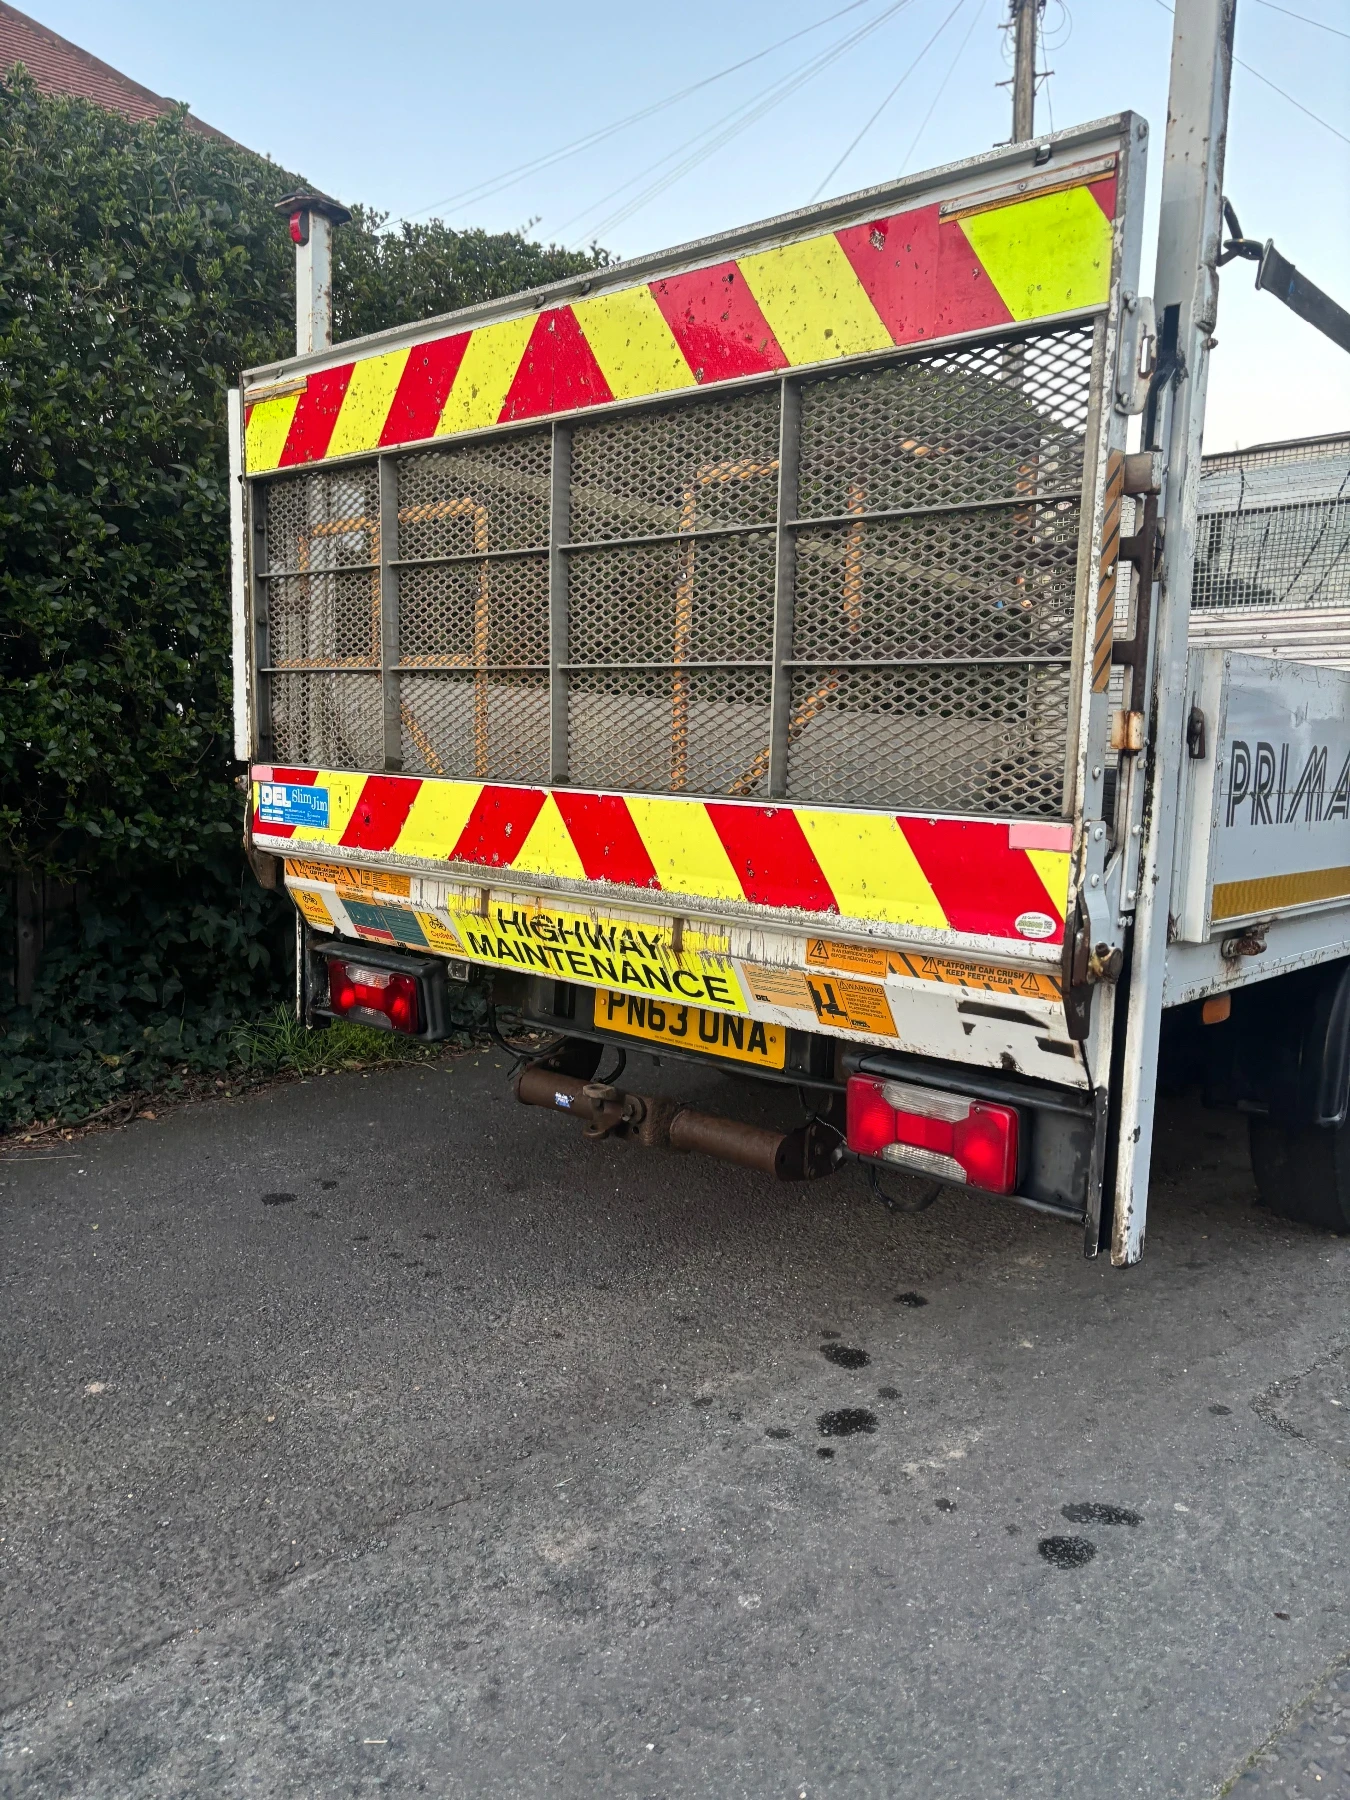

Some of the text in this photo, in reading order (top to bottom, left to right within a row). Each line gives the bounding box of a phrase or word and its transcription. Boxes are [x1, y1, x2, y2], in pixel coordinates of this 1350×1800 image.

[261, 785, 328, 811] DEL Slim Jim
[497, 908, 663, 960] HIGHWAY
[466, 931, 736, 1005] MAINTENANCE
[937, 959, 1024, 980] PLATFORM CAN CRUSH
[945, 968, 1013, 985] KEEP FEET CLEAR
[754, 993, 772, 1003] DEL
[846, 983, 883, 995] WARNING
[607, 991, 689, 1037] PN63
